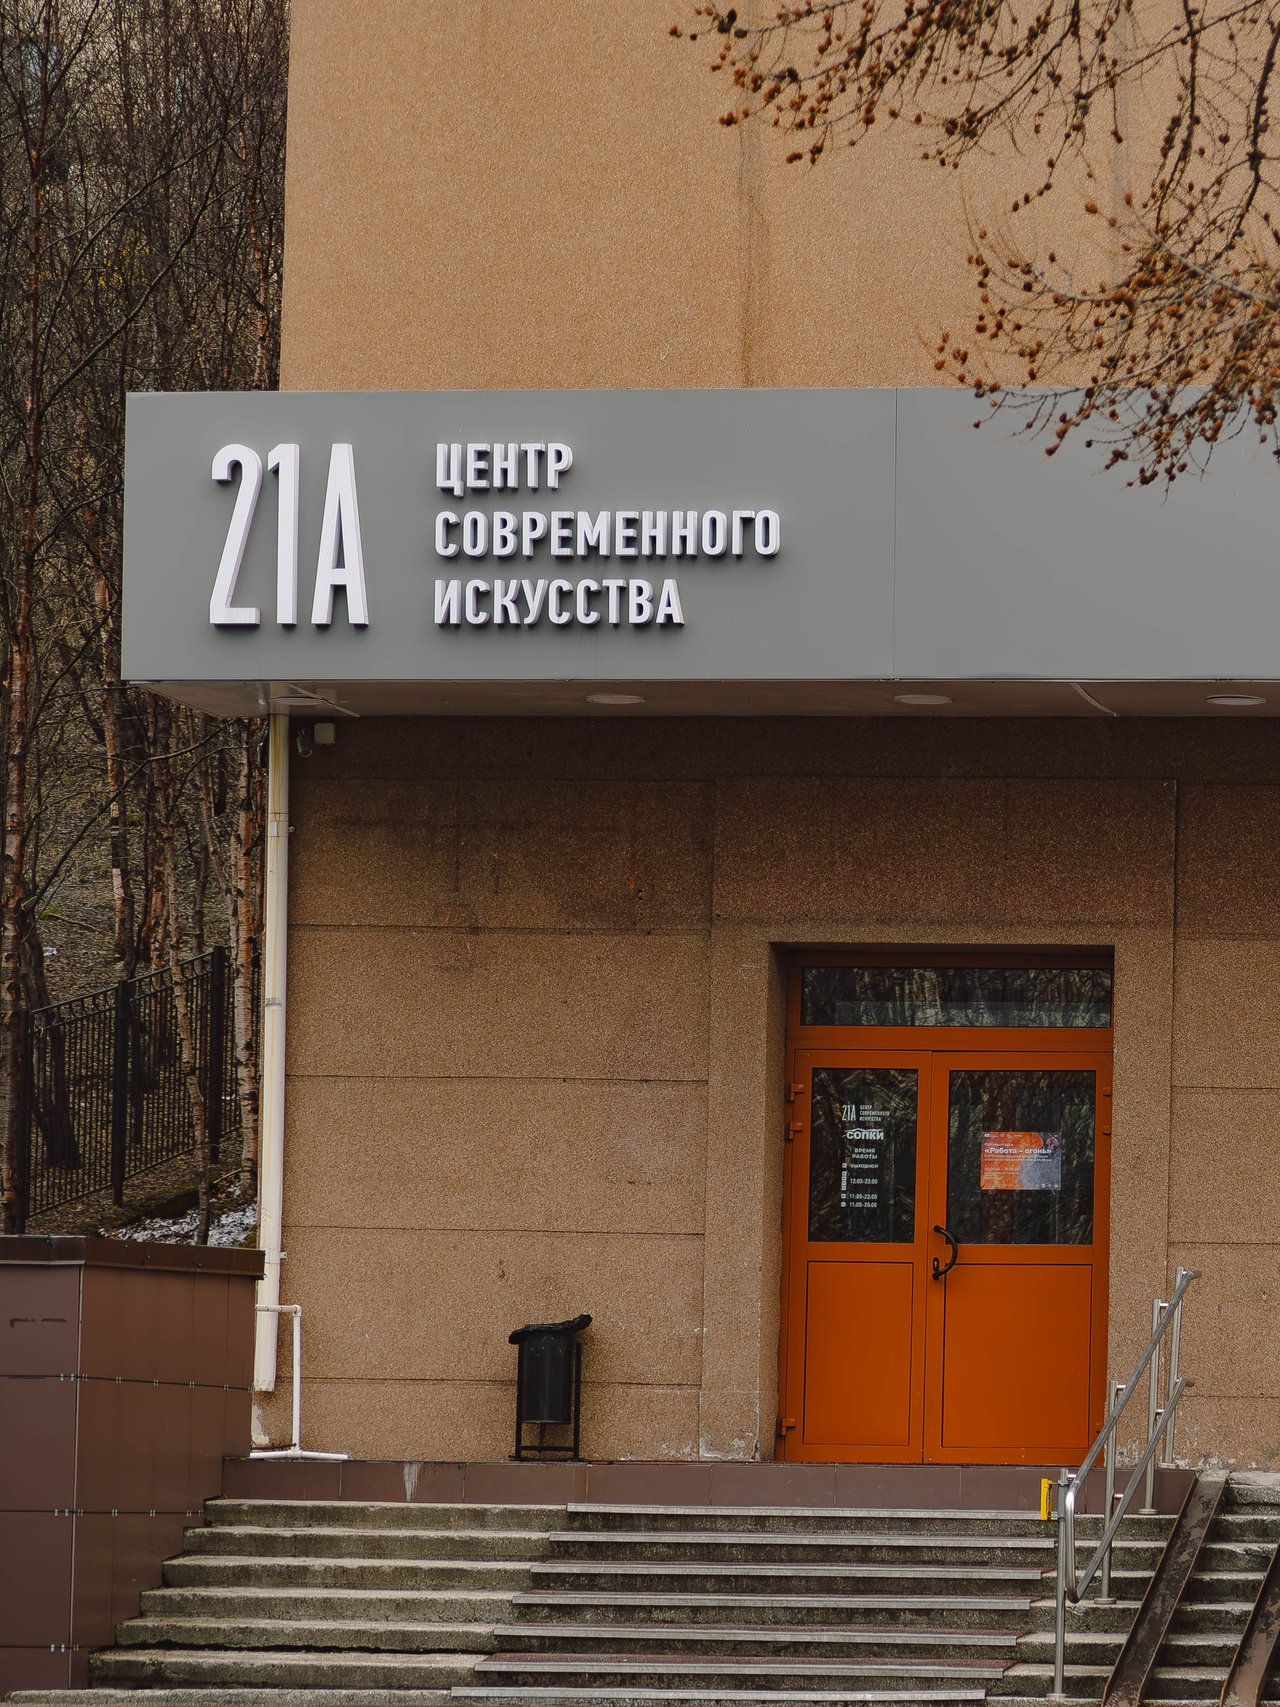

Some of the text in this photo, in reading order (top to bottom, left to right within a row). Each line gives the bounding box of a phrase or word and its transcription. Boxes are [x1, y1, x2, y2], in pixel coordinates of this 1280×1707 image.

[435, 442, 574, 498] ЦЕНТР
[209, 442, 370, 627] 21А
[434, 509, 781, 558] СОВРЕМЕННОГО
[433, 578, 686, 626] ИСКУССТВА
[842, 1104, 856, 1121] 21А
